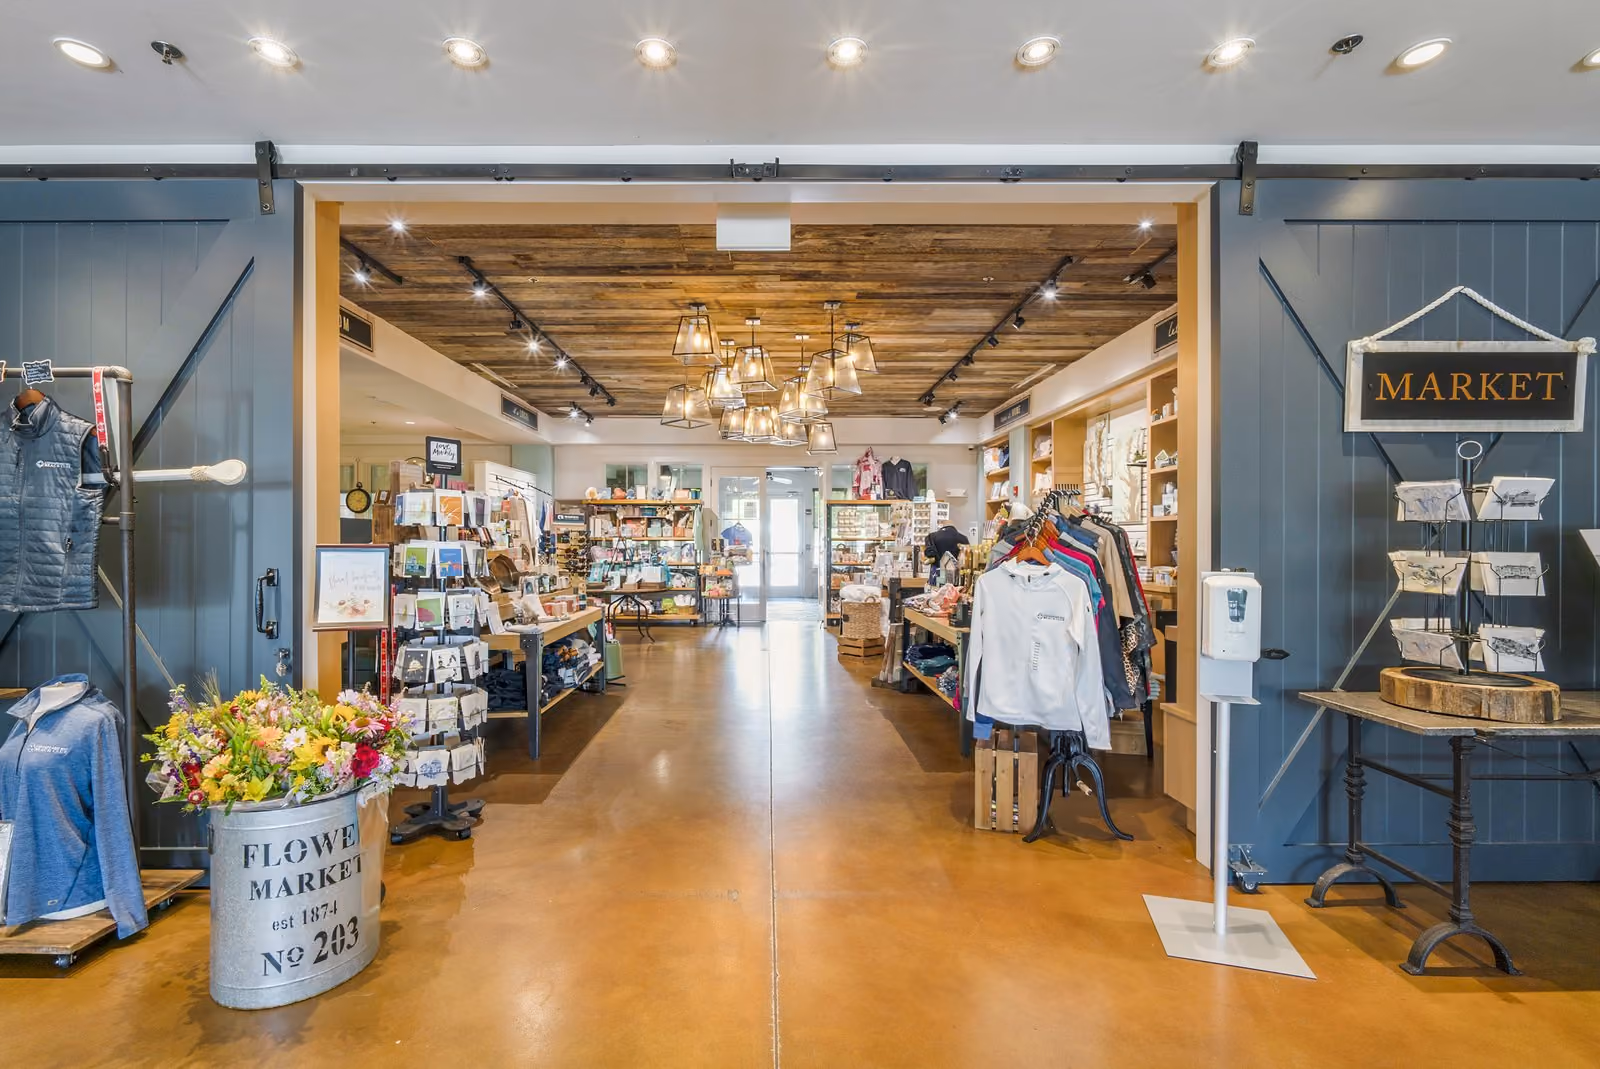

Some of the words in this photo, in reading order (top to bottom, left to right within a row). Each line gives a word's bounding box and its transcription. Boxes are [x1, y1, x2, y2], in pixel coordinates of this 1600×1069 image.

[1375, 371, 1564, 401] MARKET
[242, 823, 360, 868] FLOWE
[272, 914, 294, 931] est
[303, 899, 337, 925] 1874
[313, 916, 359, 964] 203
